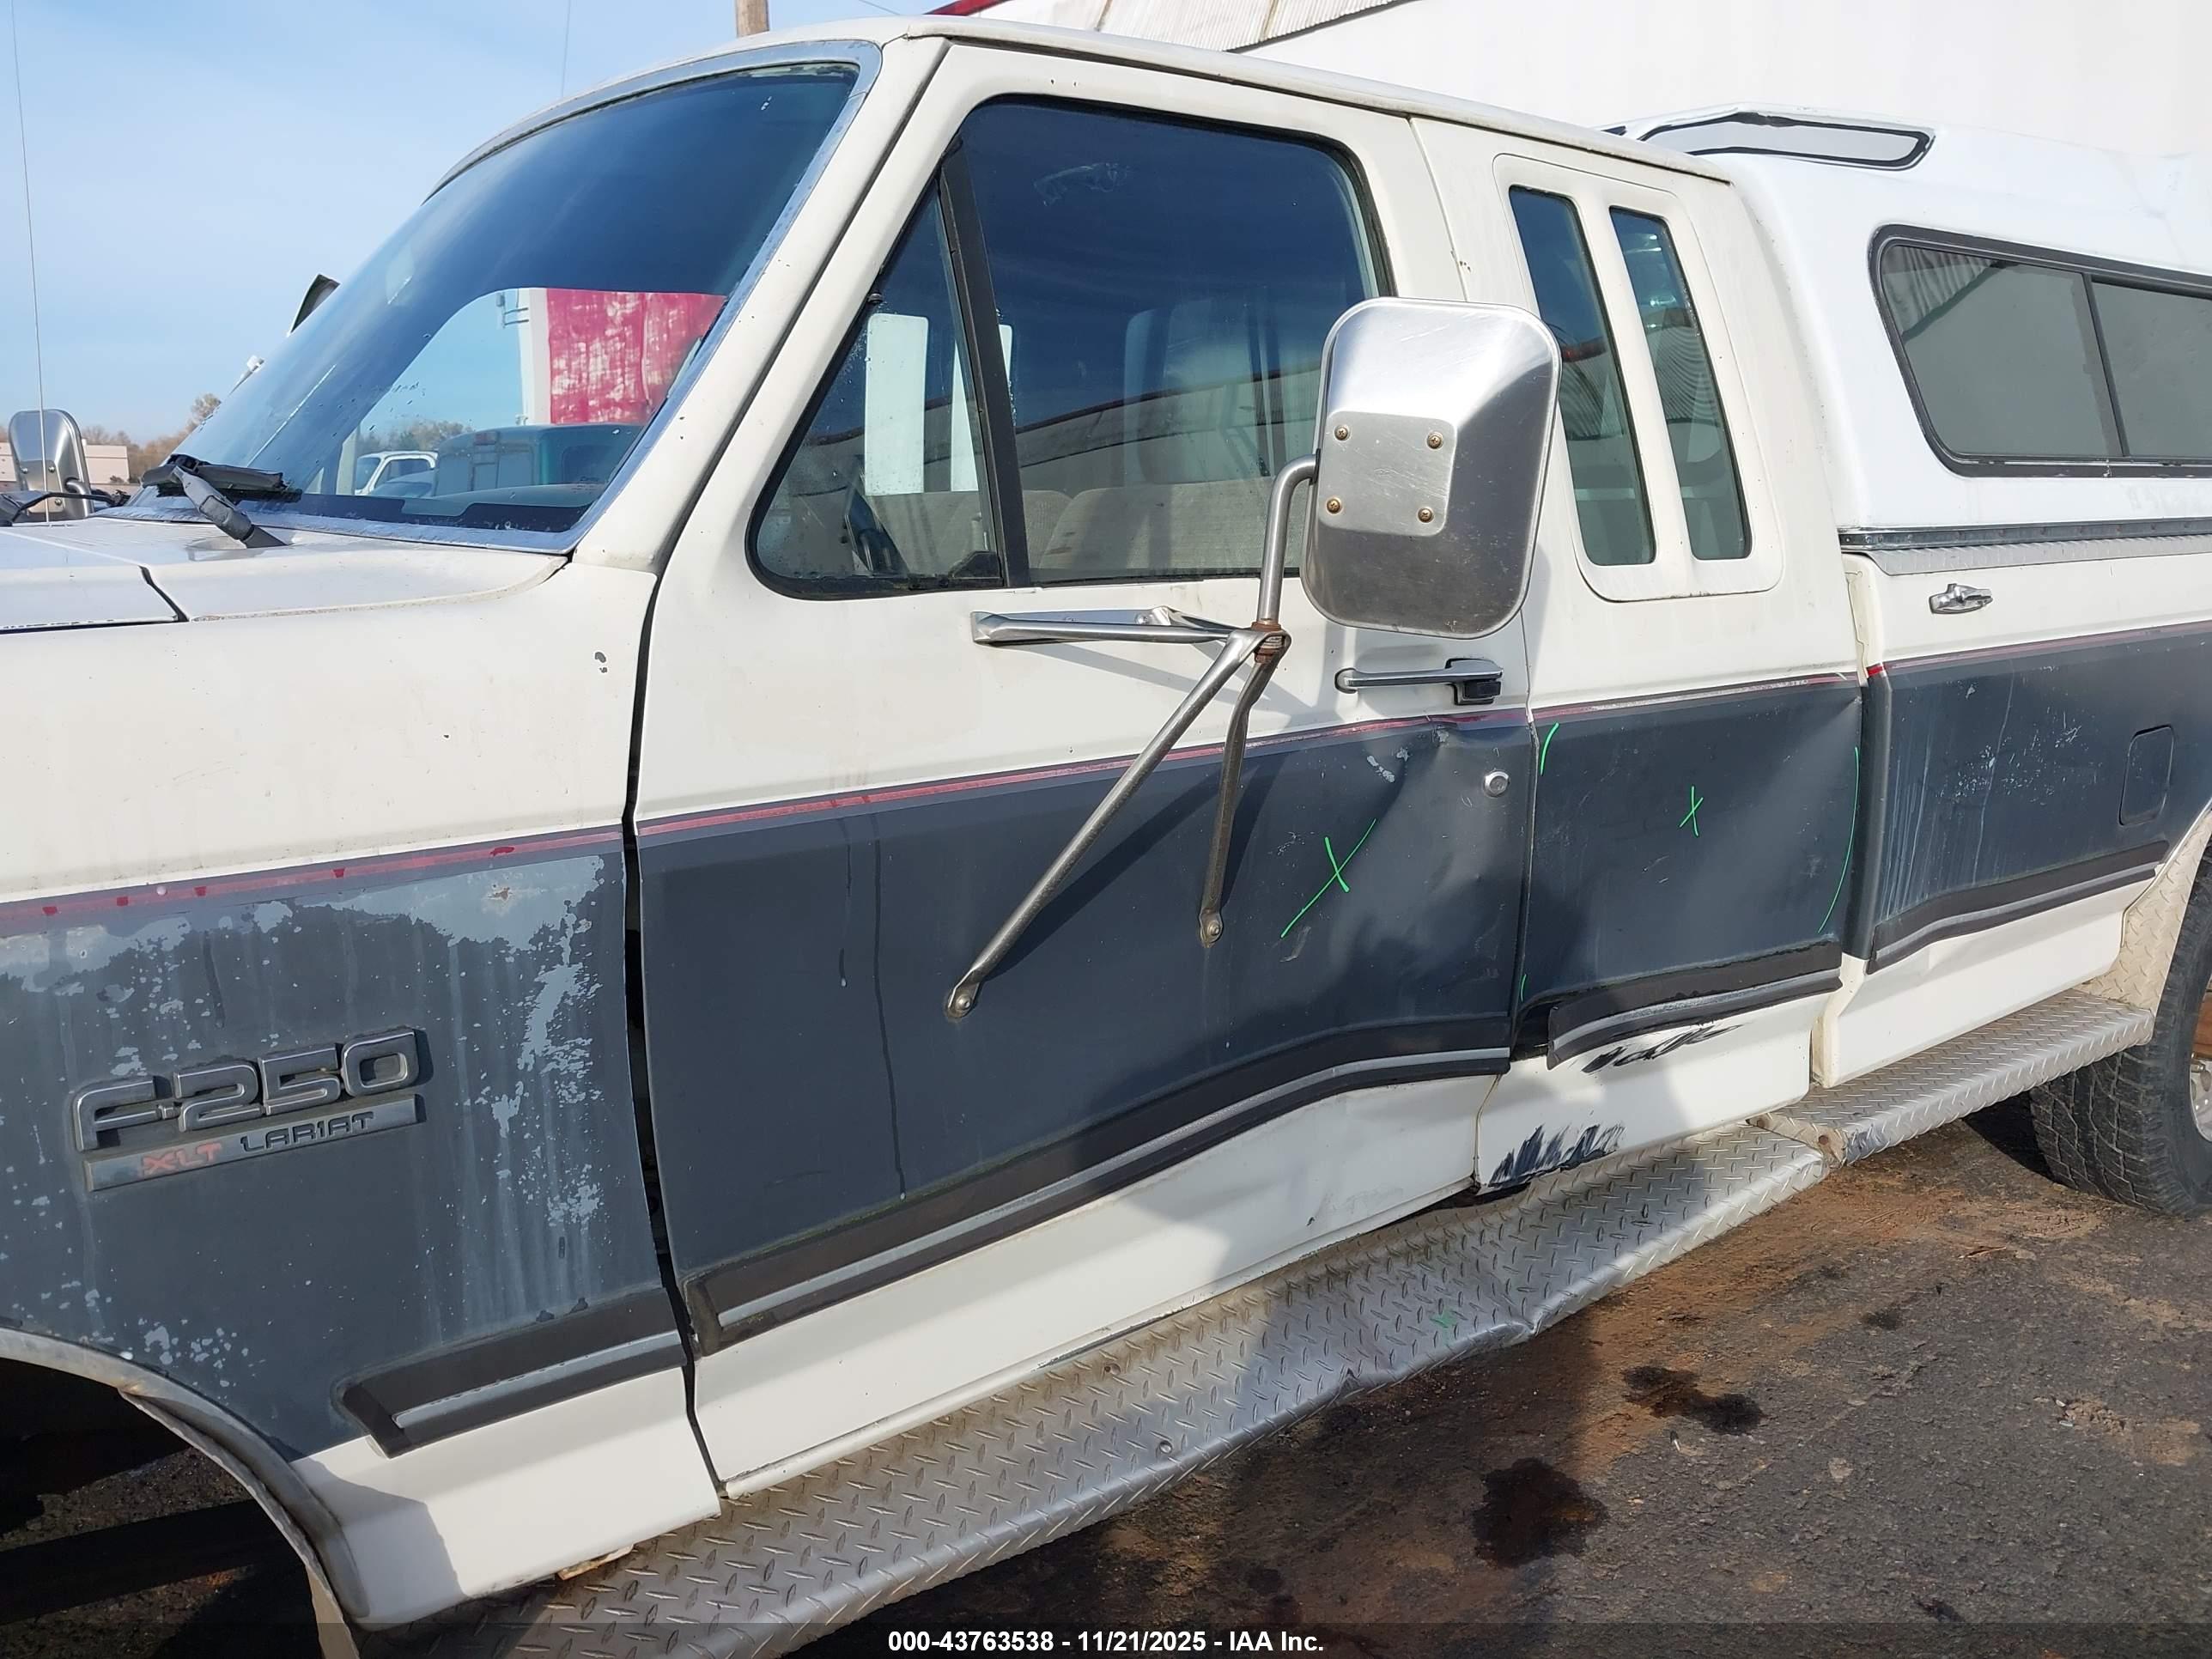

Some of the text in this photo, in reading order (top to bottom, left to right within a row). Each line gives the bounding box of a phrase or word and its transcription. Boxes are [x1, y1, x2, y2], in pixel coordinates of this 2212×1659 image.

[74, 1030, 420, 1152] F-250
[141, 1111, 374, 1177] XLT LARIAT
